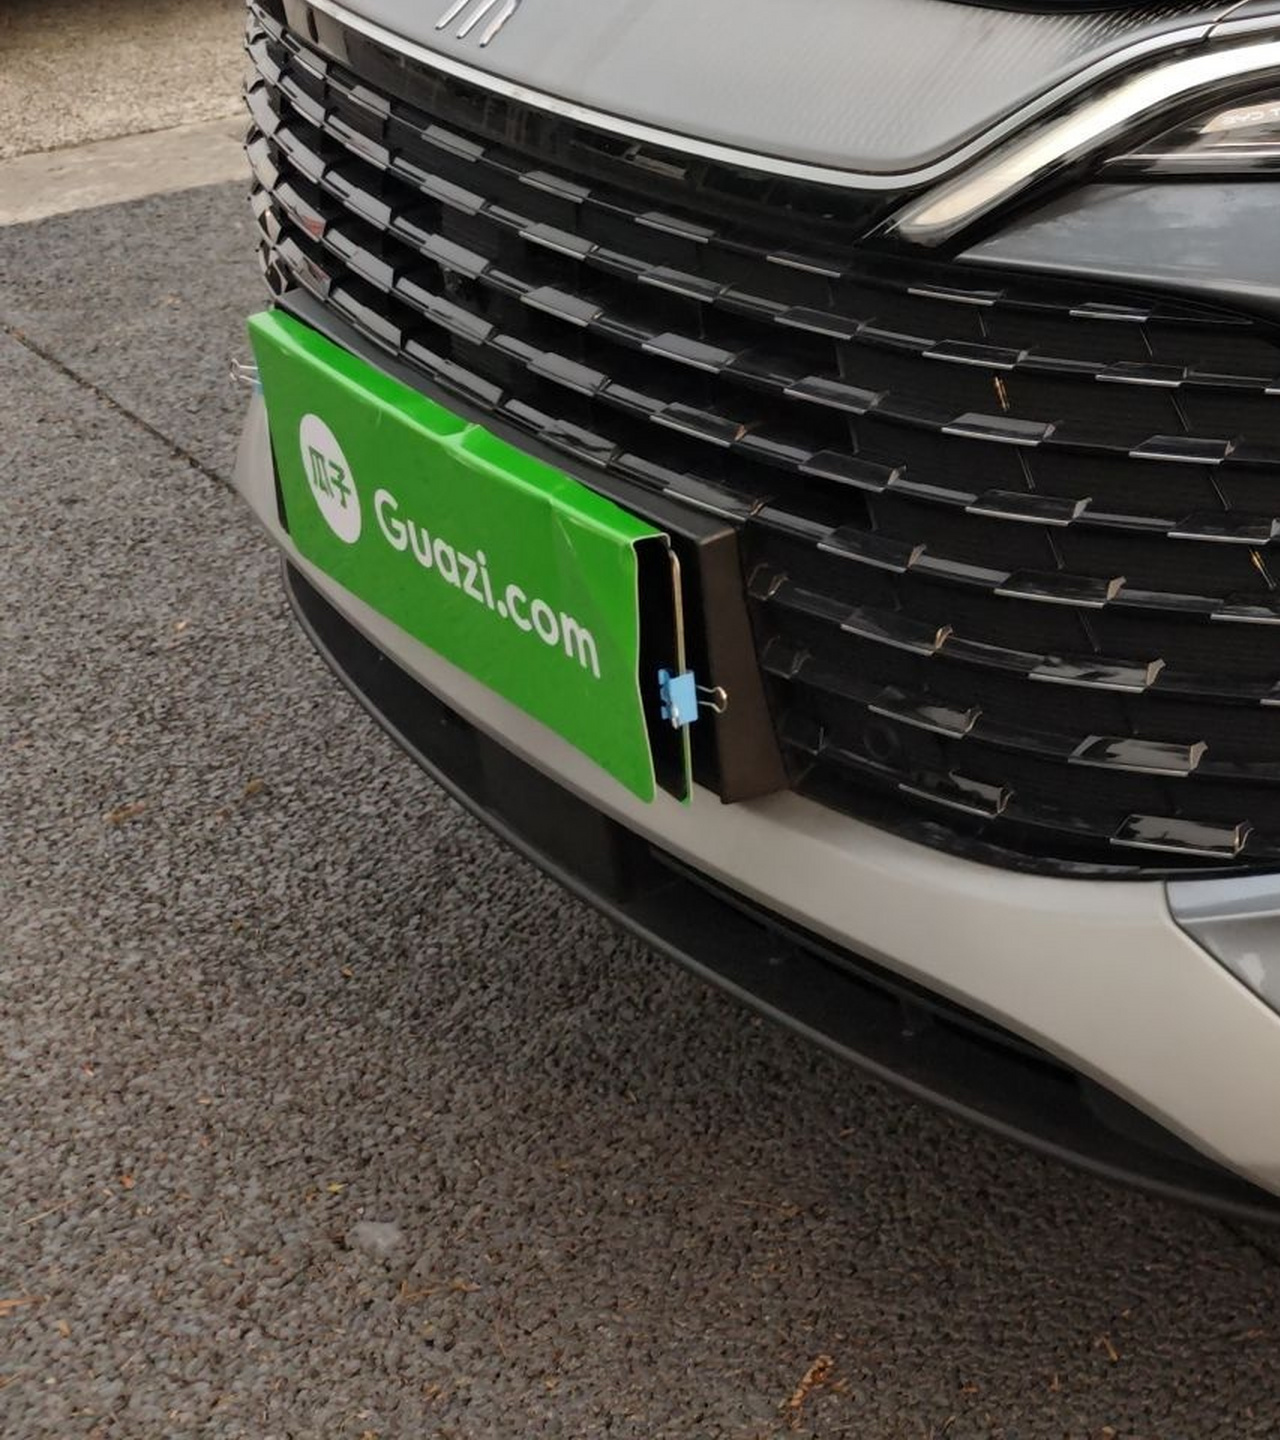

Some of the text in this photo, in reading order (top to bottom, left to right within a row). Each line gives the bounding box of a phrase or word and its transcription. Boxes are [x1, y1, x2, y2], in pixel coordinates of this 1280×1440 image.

[1223, 111, 1265, 125] BYD
[308, 444, 352, 510] 瓜子
[374, 488, 601, 678] Guazi.com
